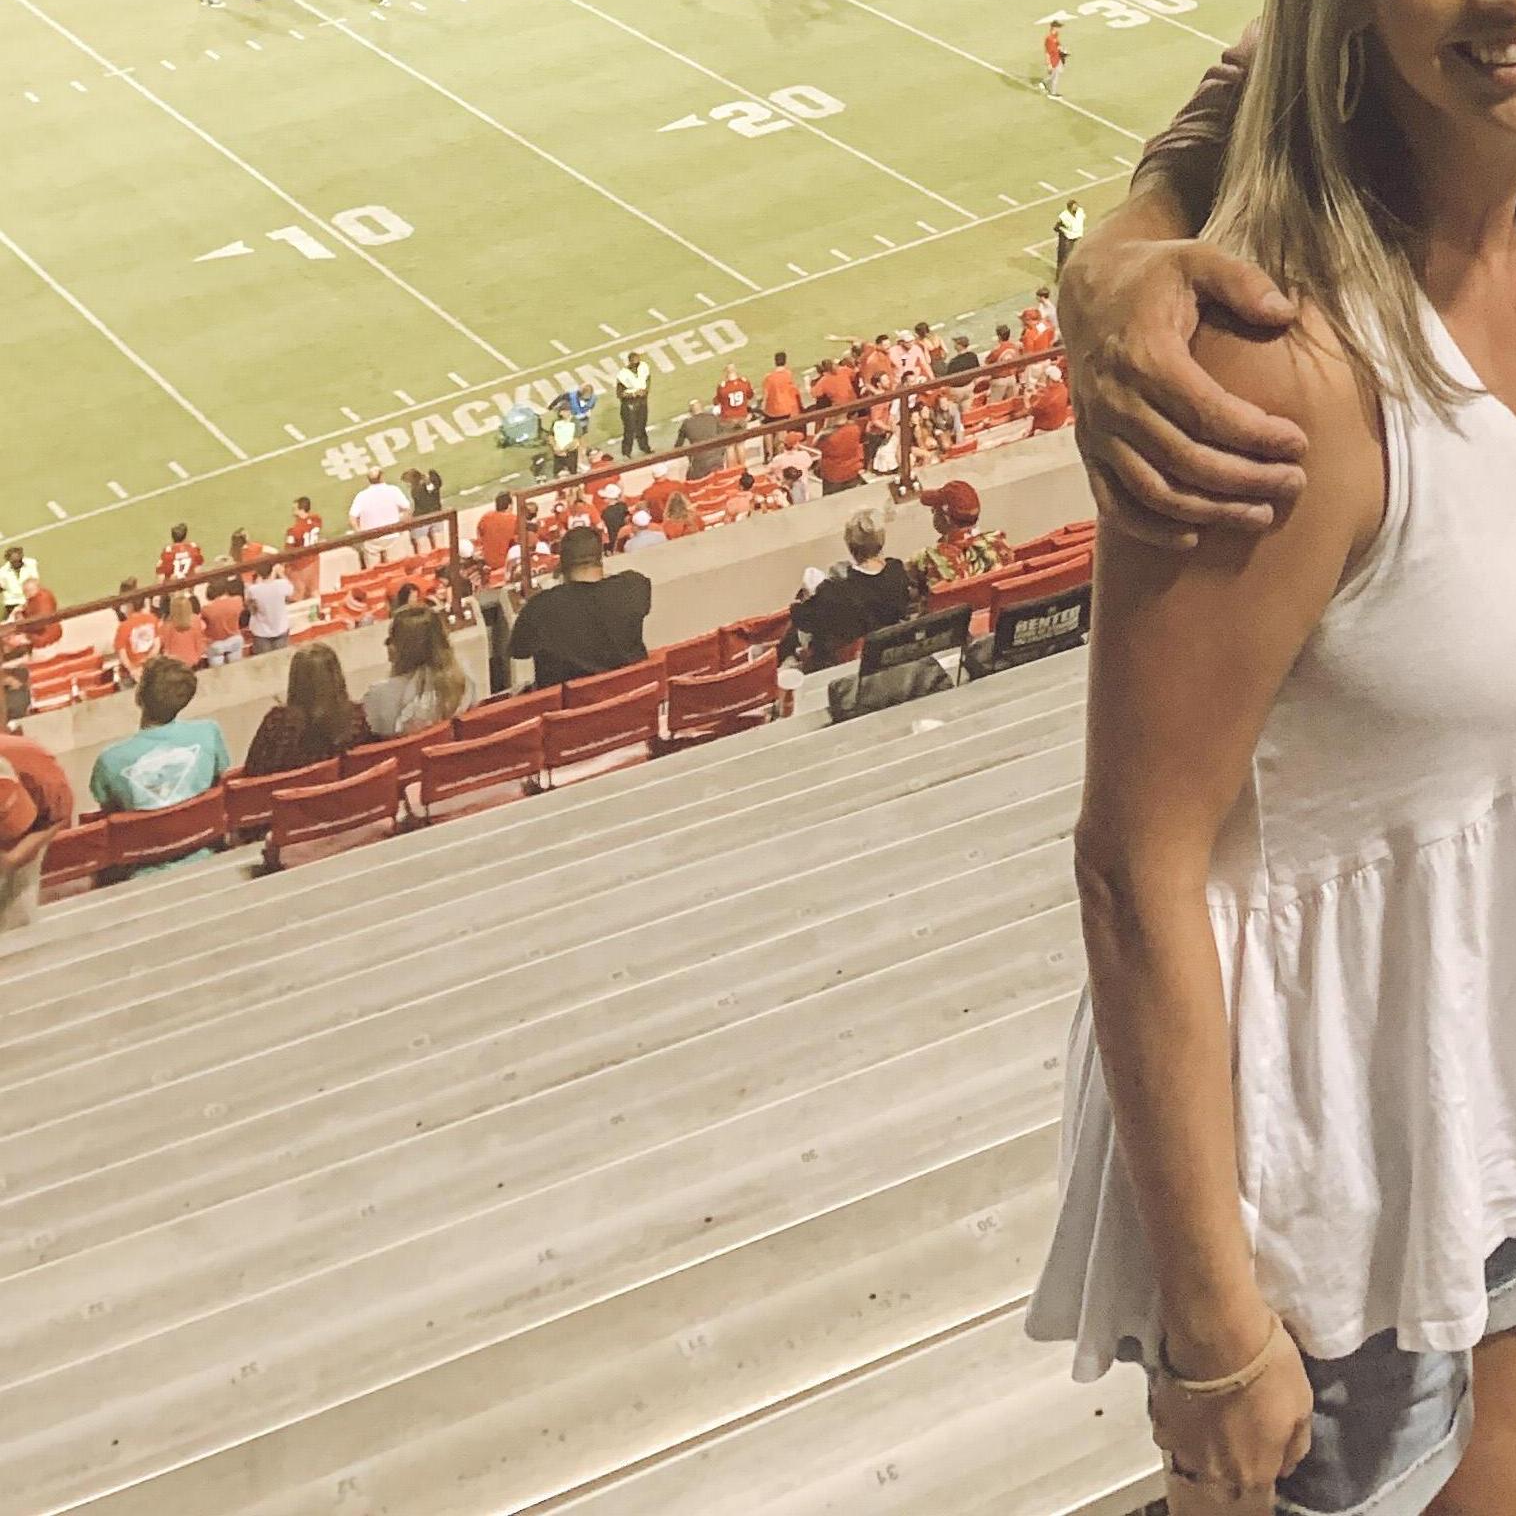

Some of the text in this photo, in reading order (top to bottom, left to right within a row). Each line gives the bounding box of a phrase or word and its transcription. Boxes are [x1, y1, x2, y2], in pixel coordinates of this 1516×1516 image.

[708, 84, 847, 138] 20
[265, 204, 415, 260] 10
[320, 318, 749, 481] #PACKUNTED
[728, 391, 744, 408] 19
[173, 558, 192, 579] 17
[976, 1216, 996, 1232] 30
[876, 1464, 900, 1487] 31
